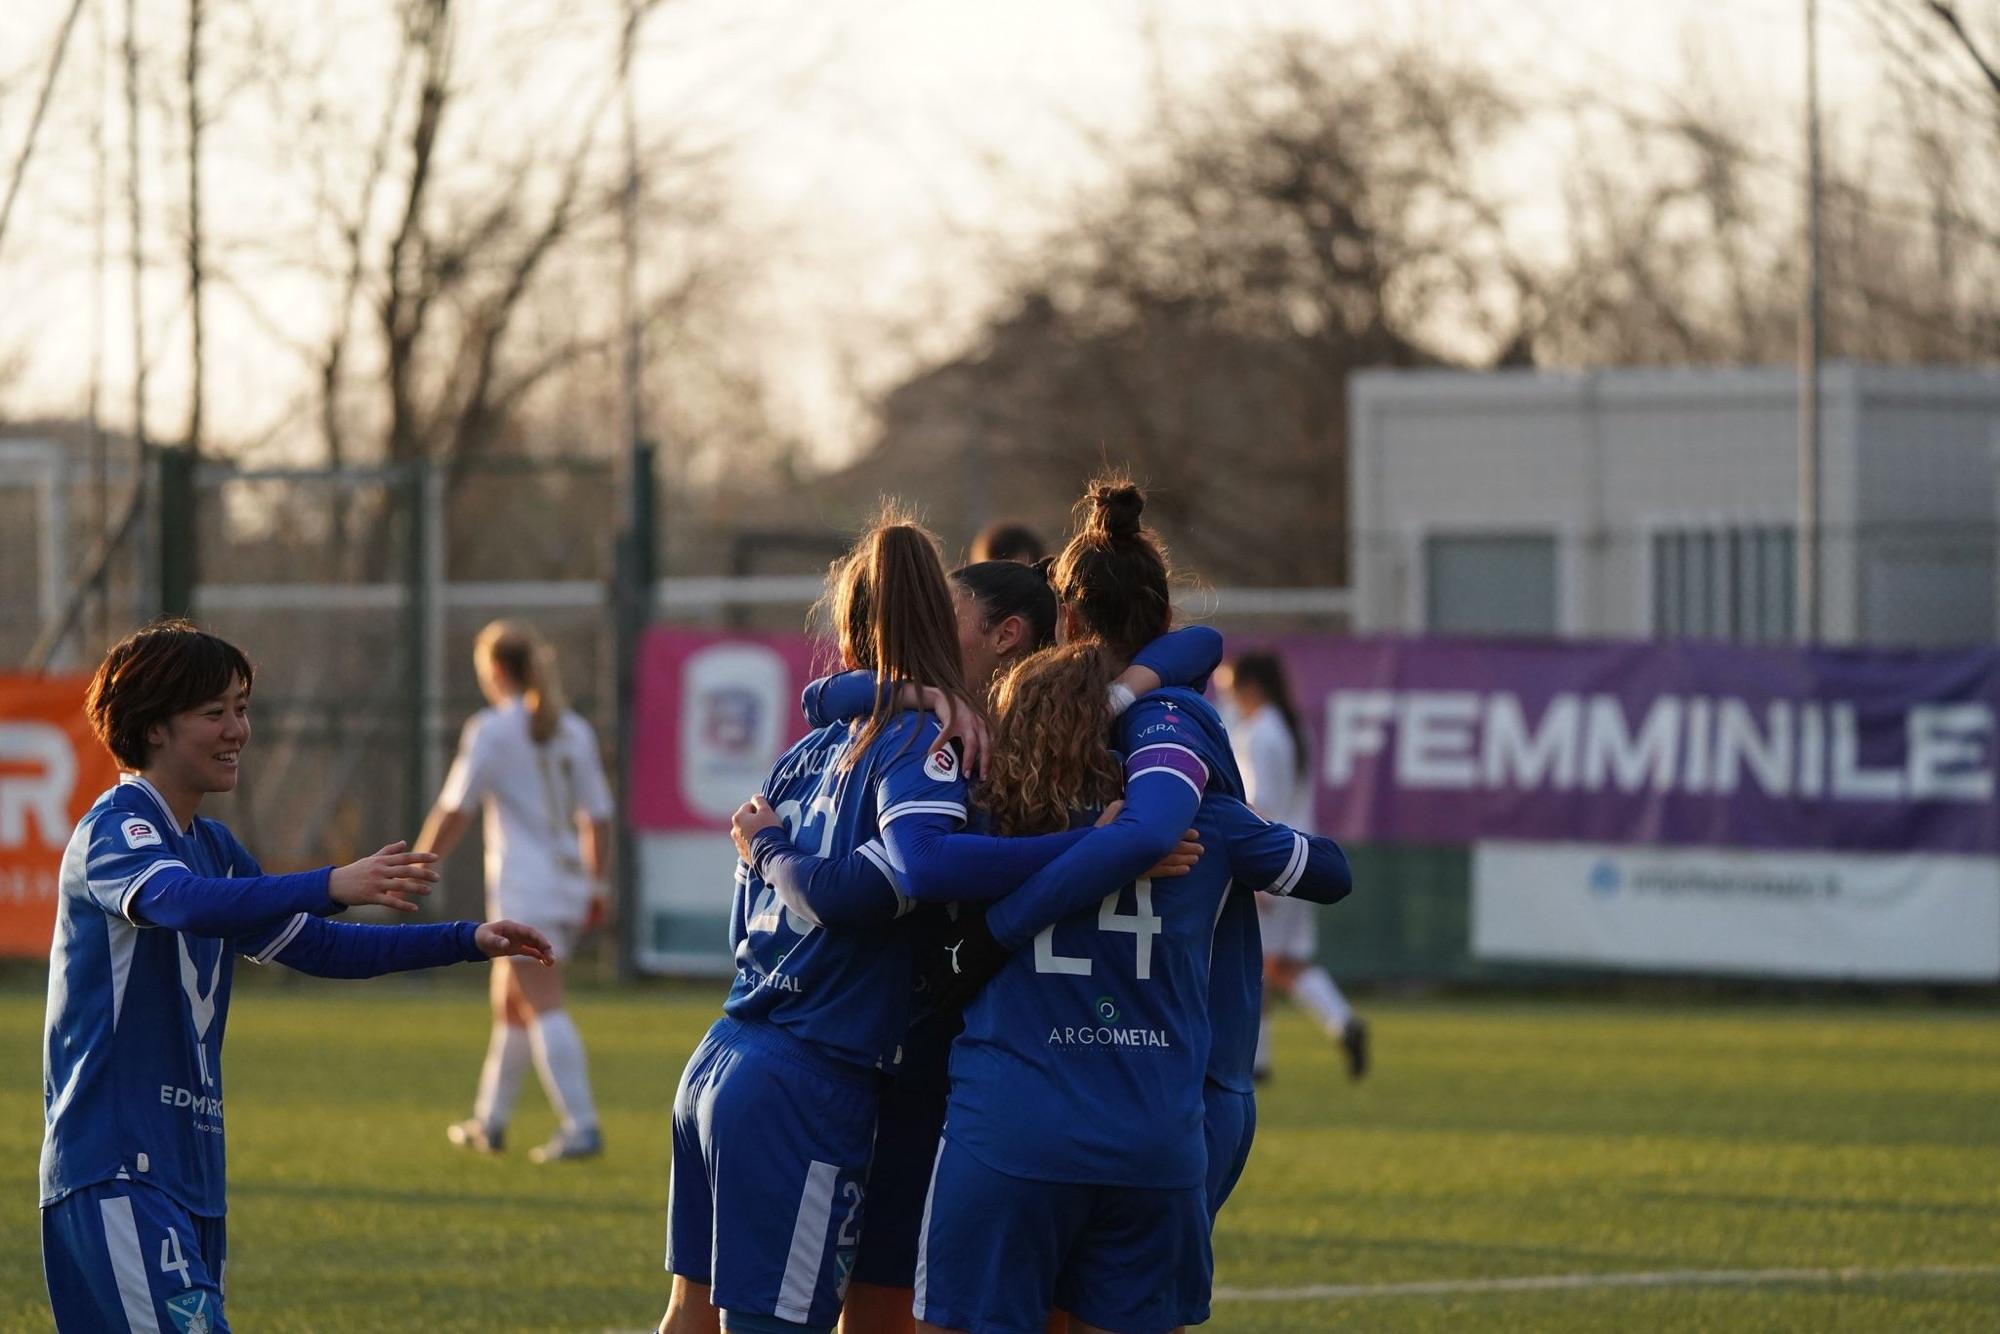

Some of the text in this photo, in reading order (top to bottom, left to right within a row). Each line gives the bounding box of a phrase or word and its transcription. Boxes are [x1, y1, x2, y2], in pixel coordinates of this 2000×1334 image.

[1137, 723, 1177, 738] VERA
[1325, 691, 1994, 799] FEMMINILE
[1048, 1026, 1170, 1047] ARGOMETAL
[837, 1181, 865, 1246] 2
[160, 1227, 192, 1288] 4
